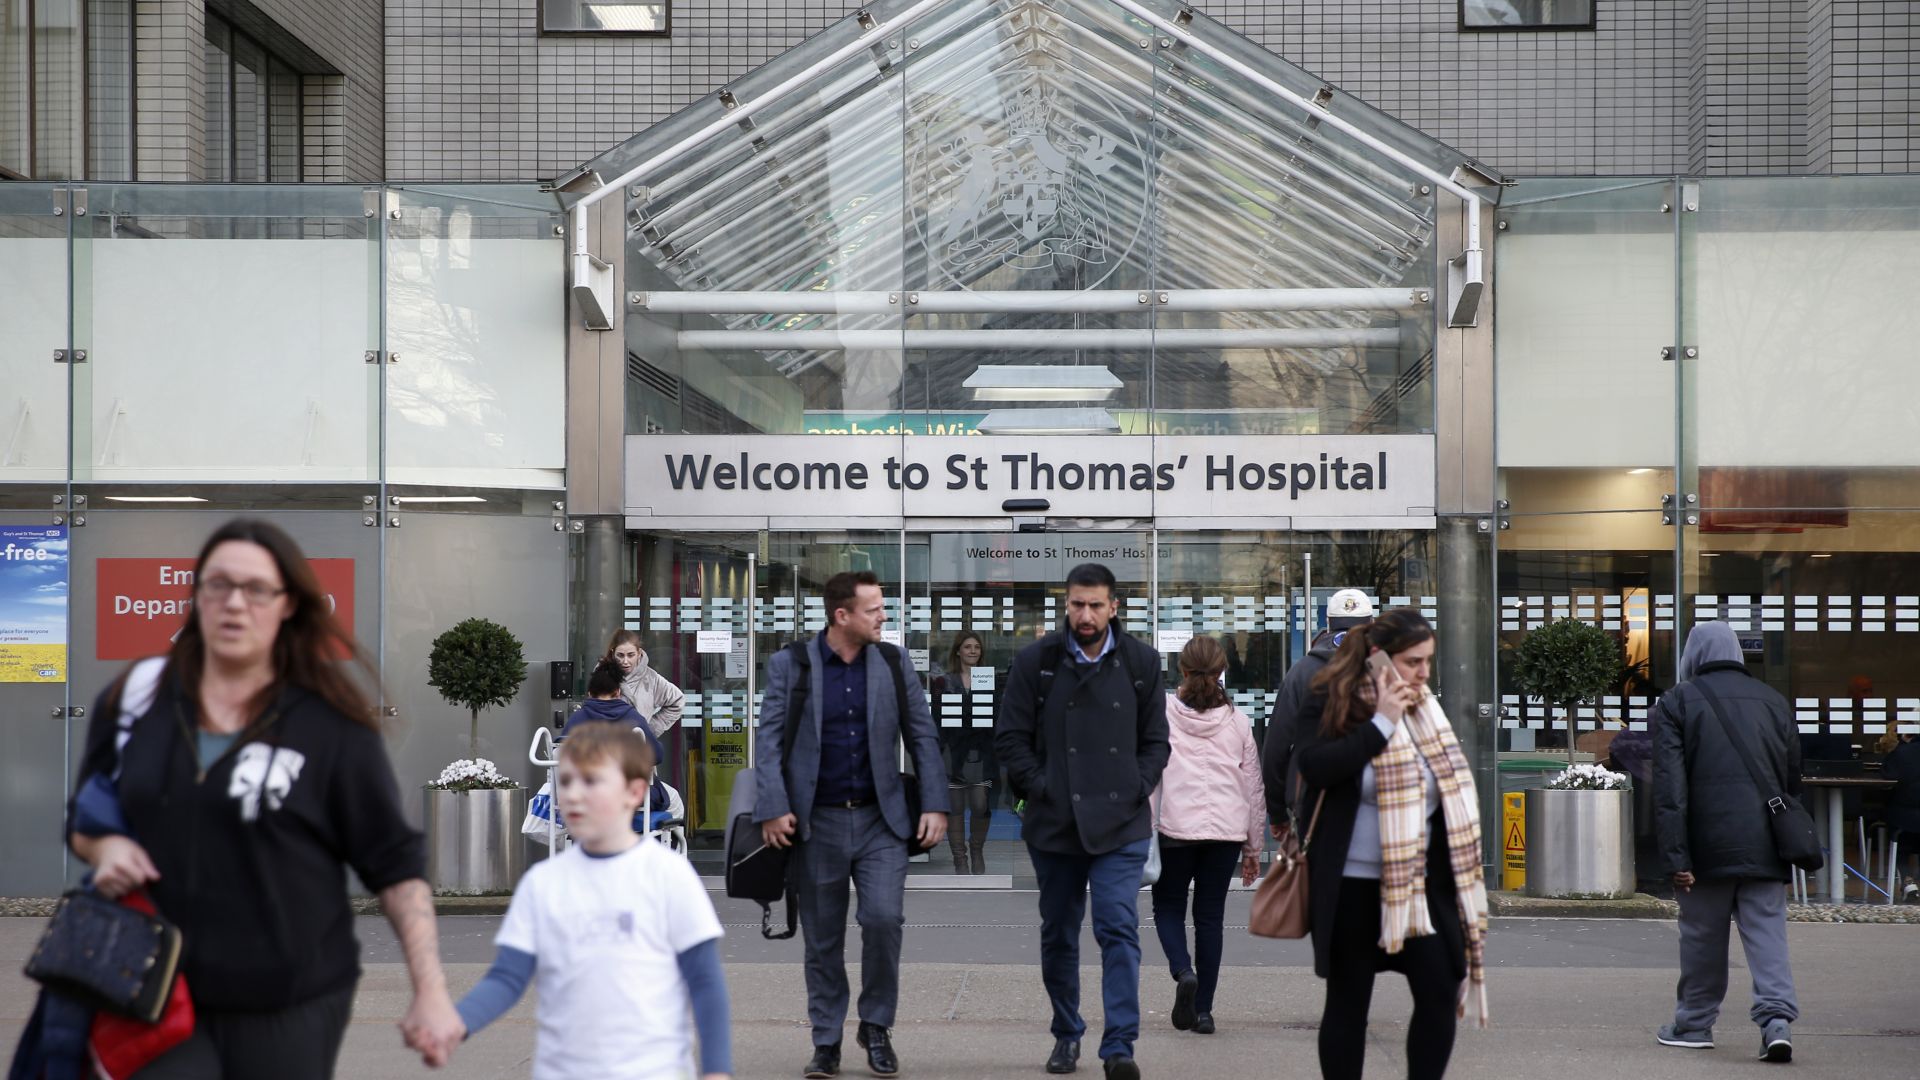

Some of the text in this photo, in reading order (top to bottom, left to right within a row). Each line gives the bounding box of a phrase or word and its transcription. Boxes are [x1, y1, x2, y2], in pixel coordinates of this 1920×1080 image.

[664, 451, 869, 491] Welcome
[883, 455, 930, 491] to
[945, 454, 989, 491] St
[1205, 451, 1387, 500] Hospital
[966, 547, 1023, 559] Welcome
[1026, 548, 1040, 559] to
[1044, 547, 1057, 559] St
